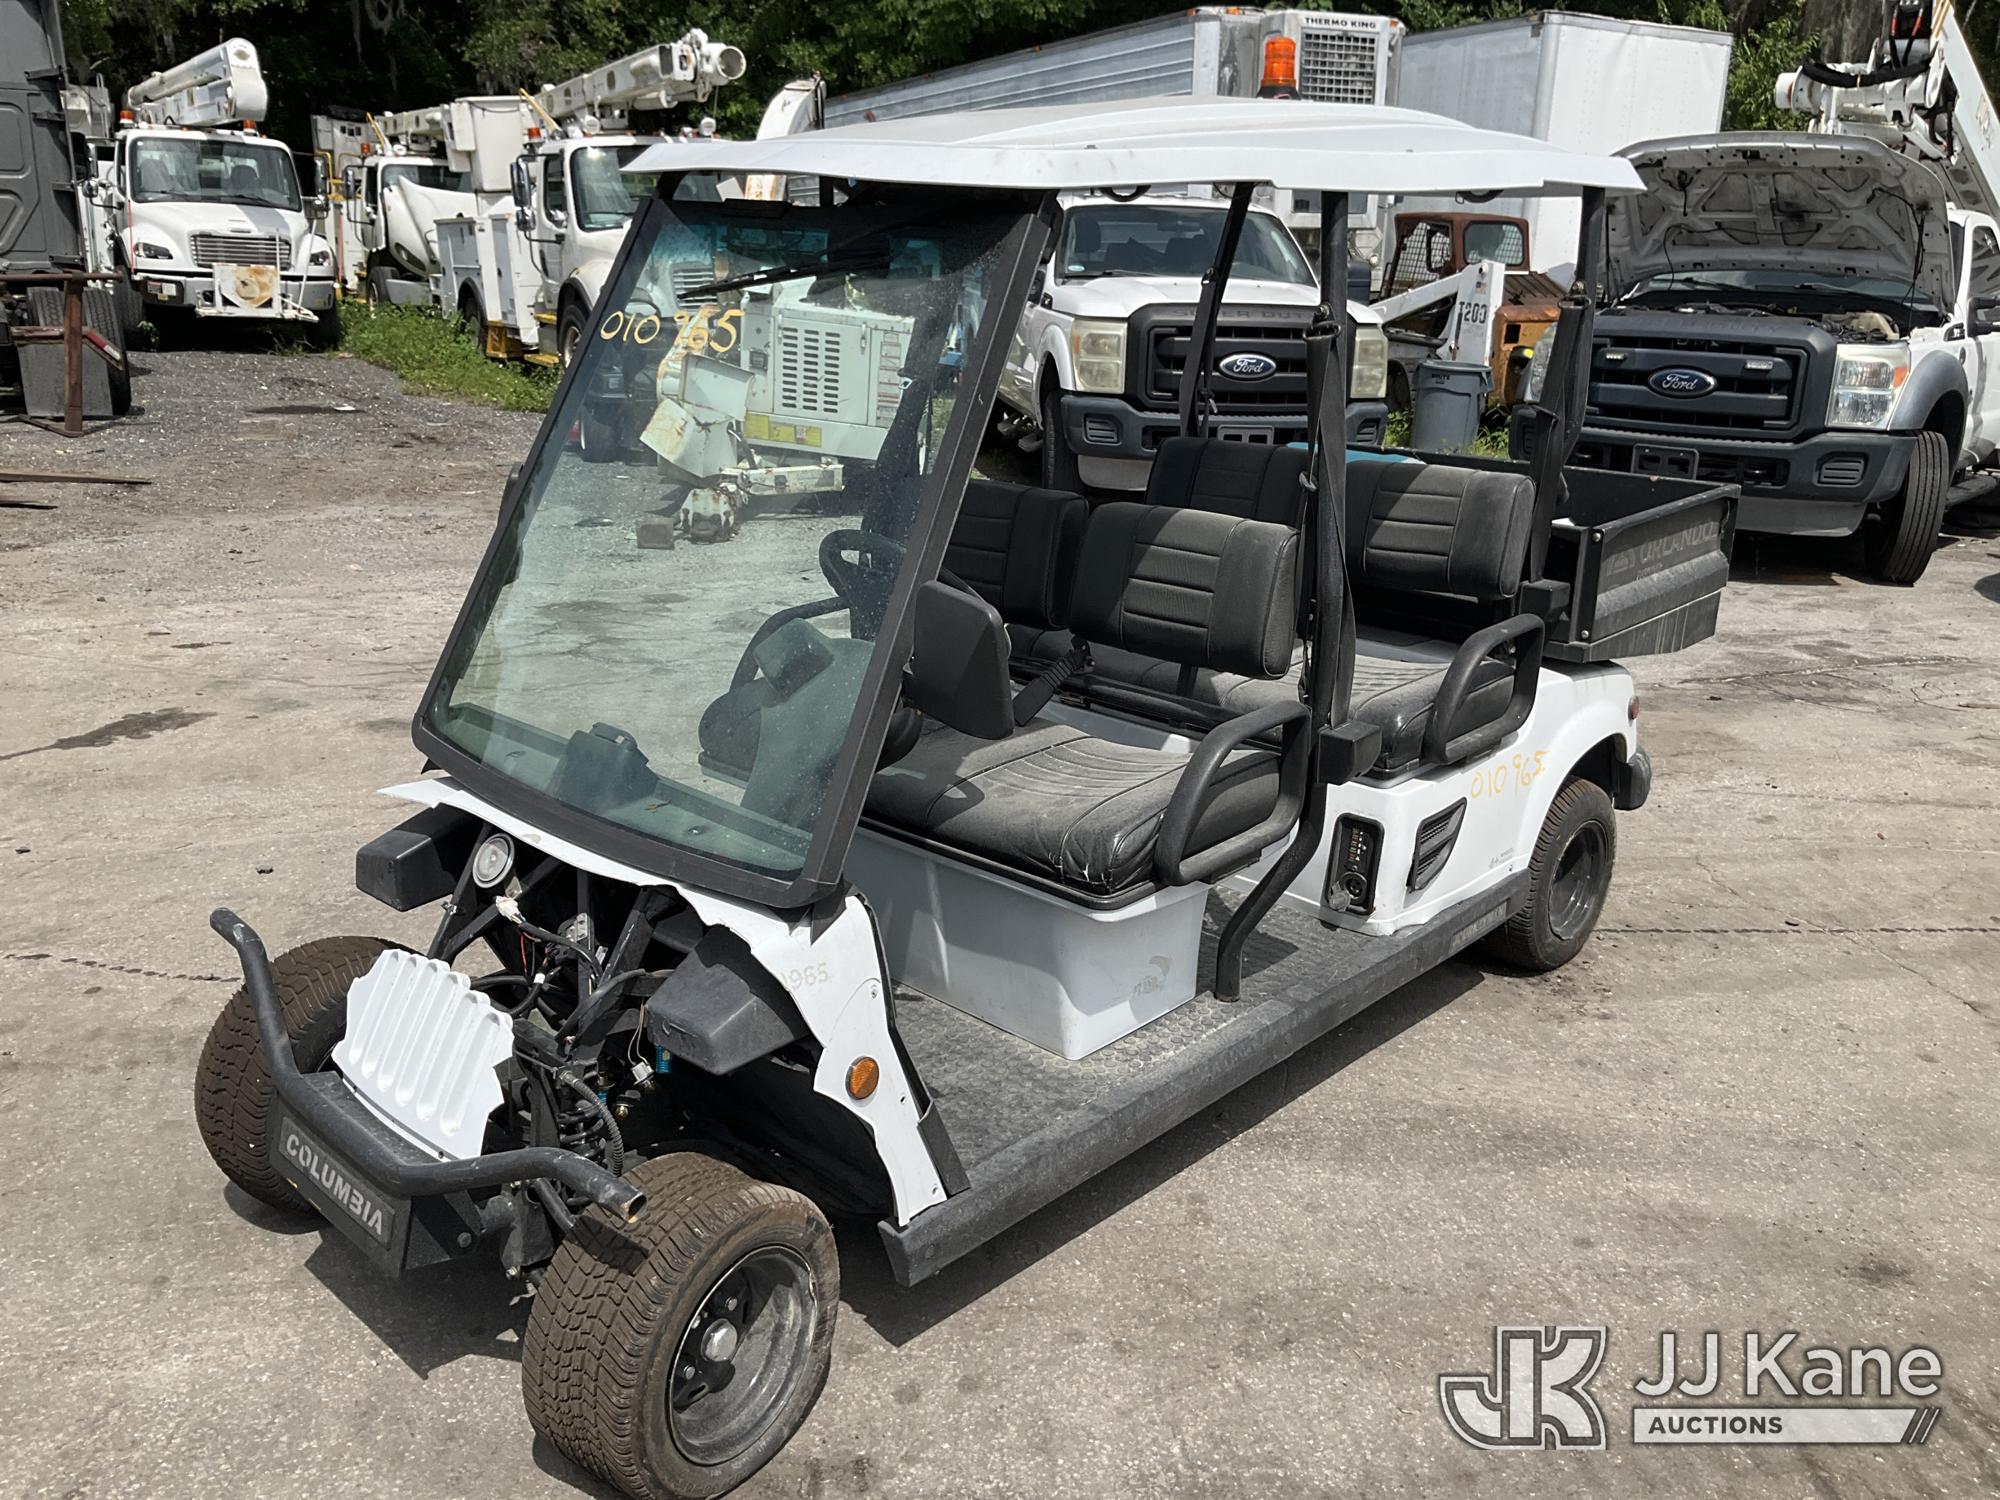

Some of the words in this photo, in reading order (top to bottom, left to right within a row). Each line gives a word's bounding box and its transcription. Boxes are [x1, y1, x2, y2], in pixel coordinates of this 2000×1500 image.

[1305, 17, 1347, 27] THERMO
[1351, 21, 1376, 29] KING
[1232, 357, 1264, 374] Ford
[1661, 373, 1698, 391] Ford
[286, 1133, 383, 1235] COLUMBIA
